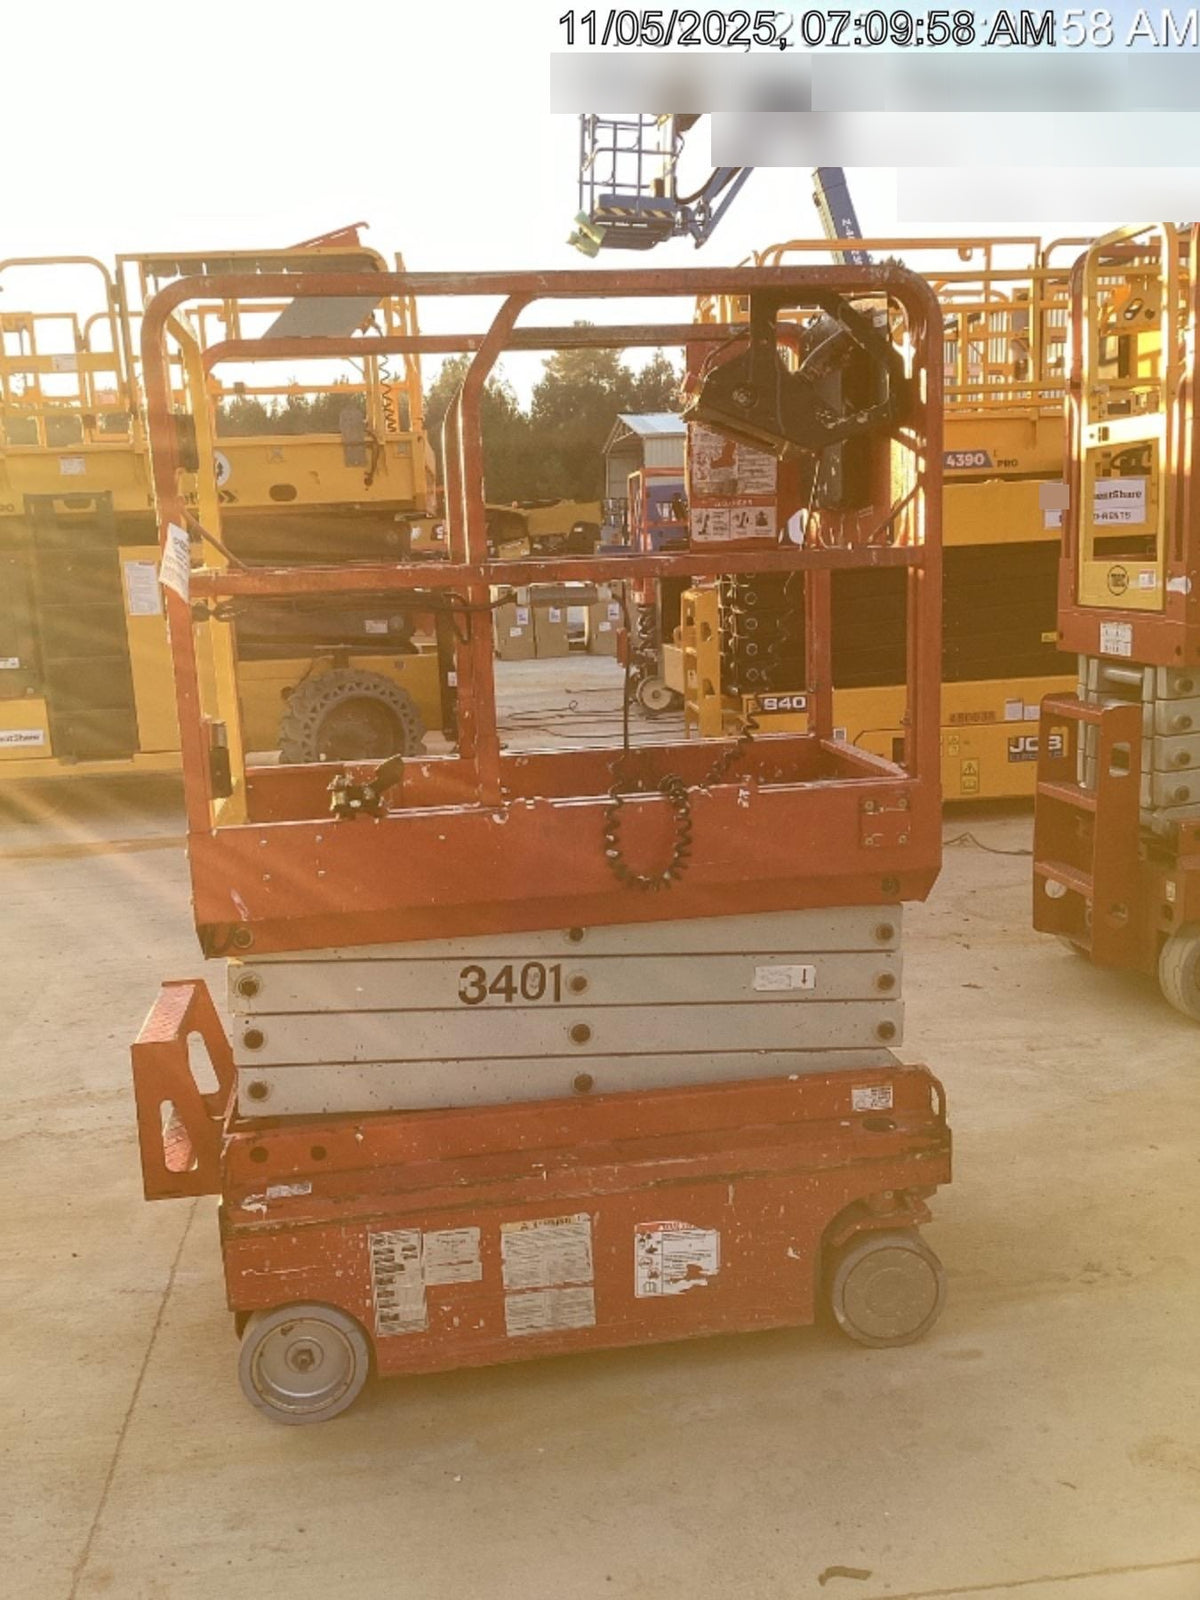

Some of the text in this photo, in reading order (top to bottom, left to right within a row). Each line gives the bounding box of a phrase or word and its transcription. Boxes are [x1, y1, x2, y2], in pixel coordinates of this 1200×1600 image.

[946, 453, 985, 467] 4390
[1008, 735, 1062, 753] JCB
[458, 961, 561, 1005] 3401
